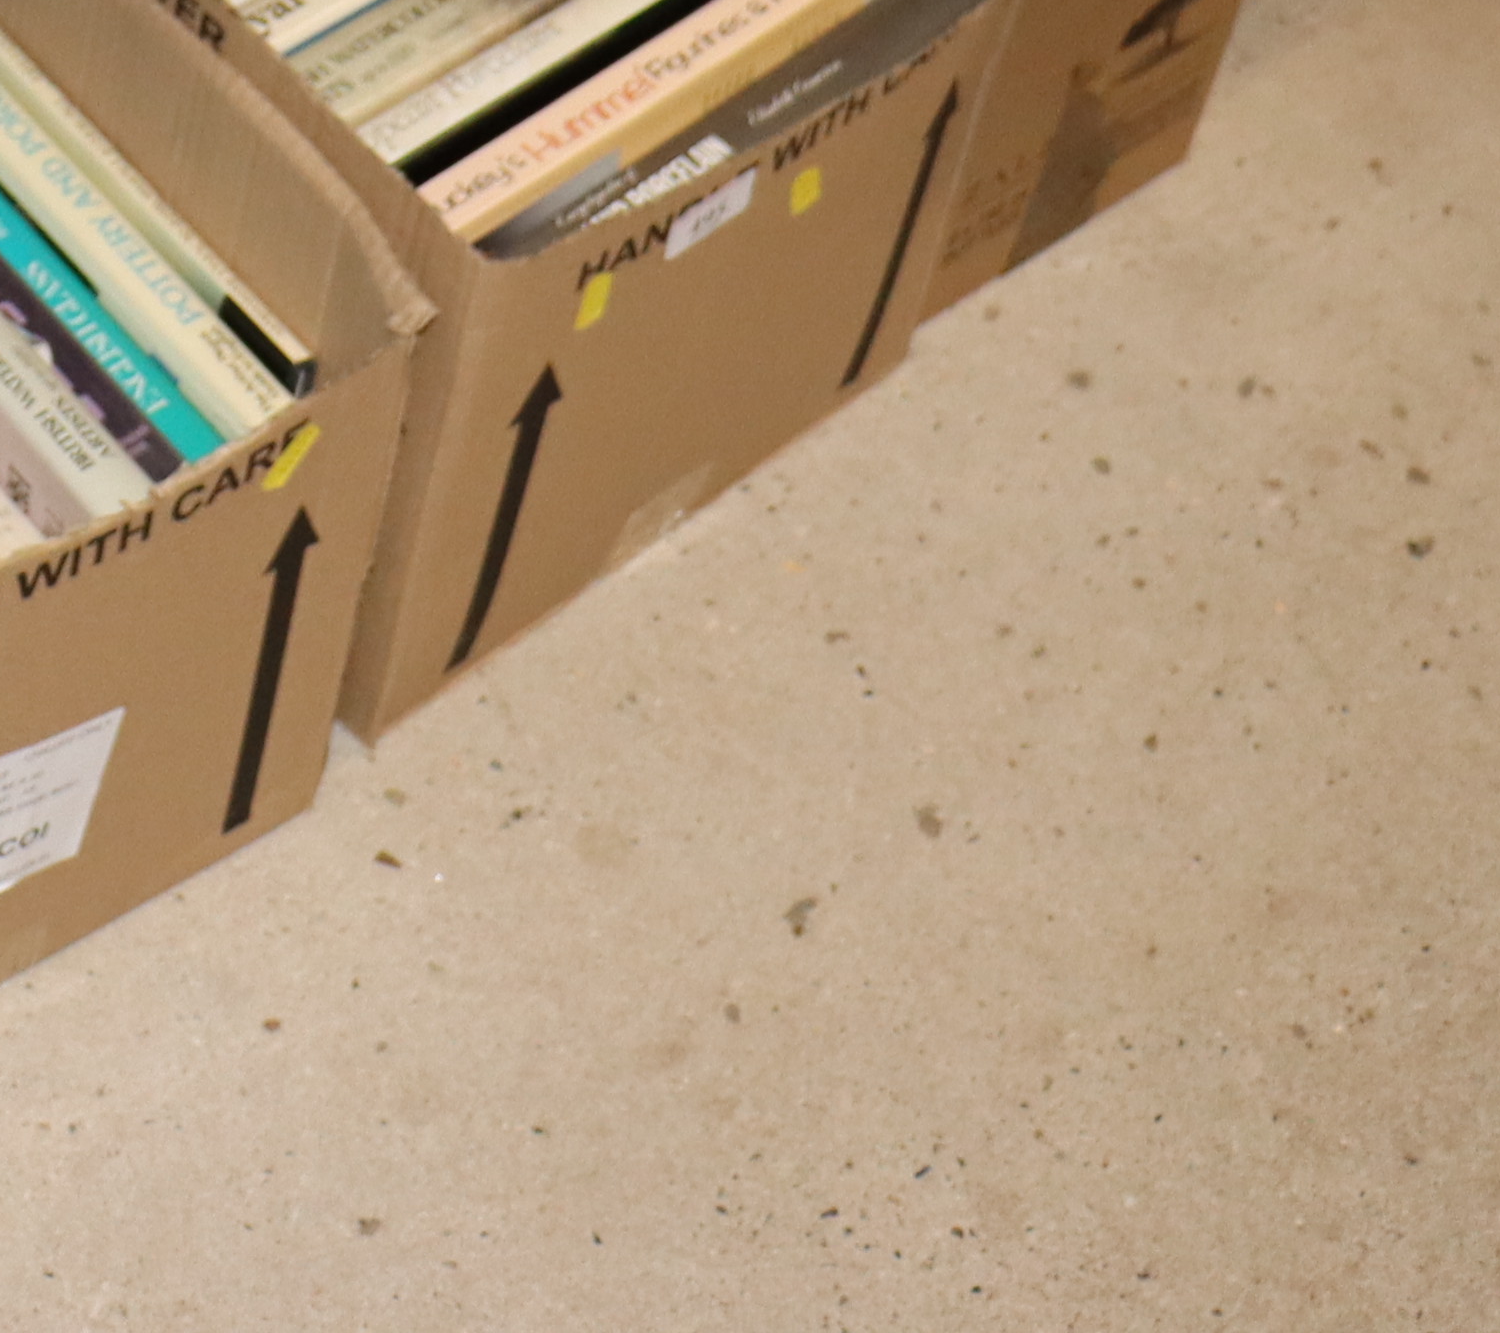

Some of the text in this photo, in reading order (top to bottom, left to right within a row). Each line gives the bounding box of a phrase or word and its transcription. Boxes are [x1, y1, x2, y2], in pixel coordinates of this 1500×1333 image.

[520, 68, 654, 167] Hummel
[772, 87, 872, 173] WITH
[37, 156, 101, 216] AND
[86, 213, 206, 328] POTTERY
[33, 408, 96, 472] BRITISH
[51, 390, 112, 458] ARTISTS
[15, 510, 158, 601] WITH
